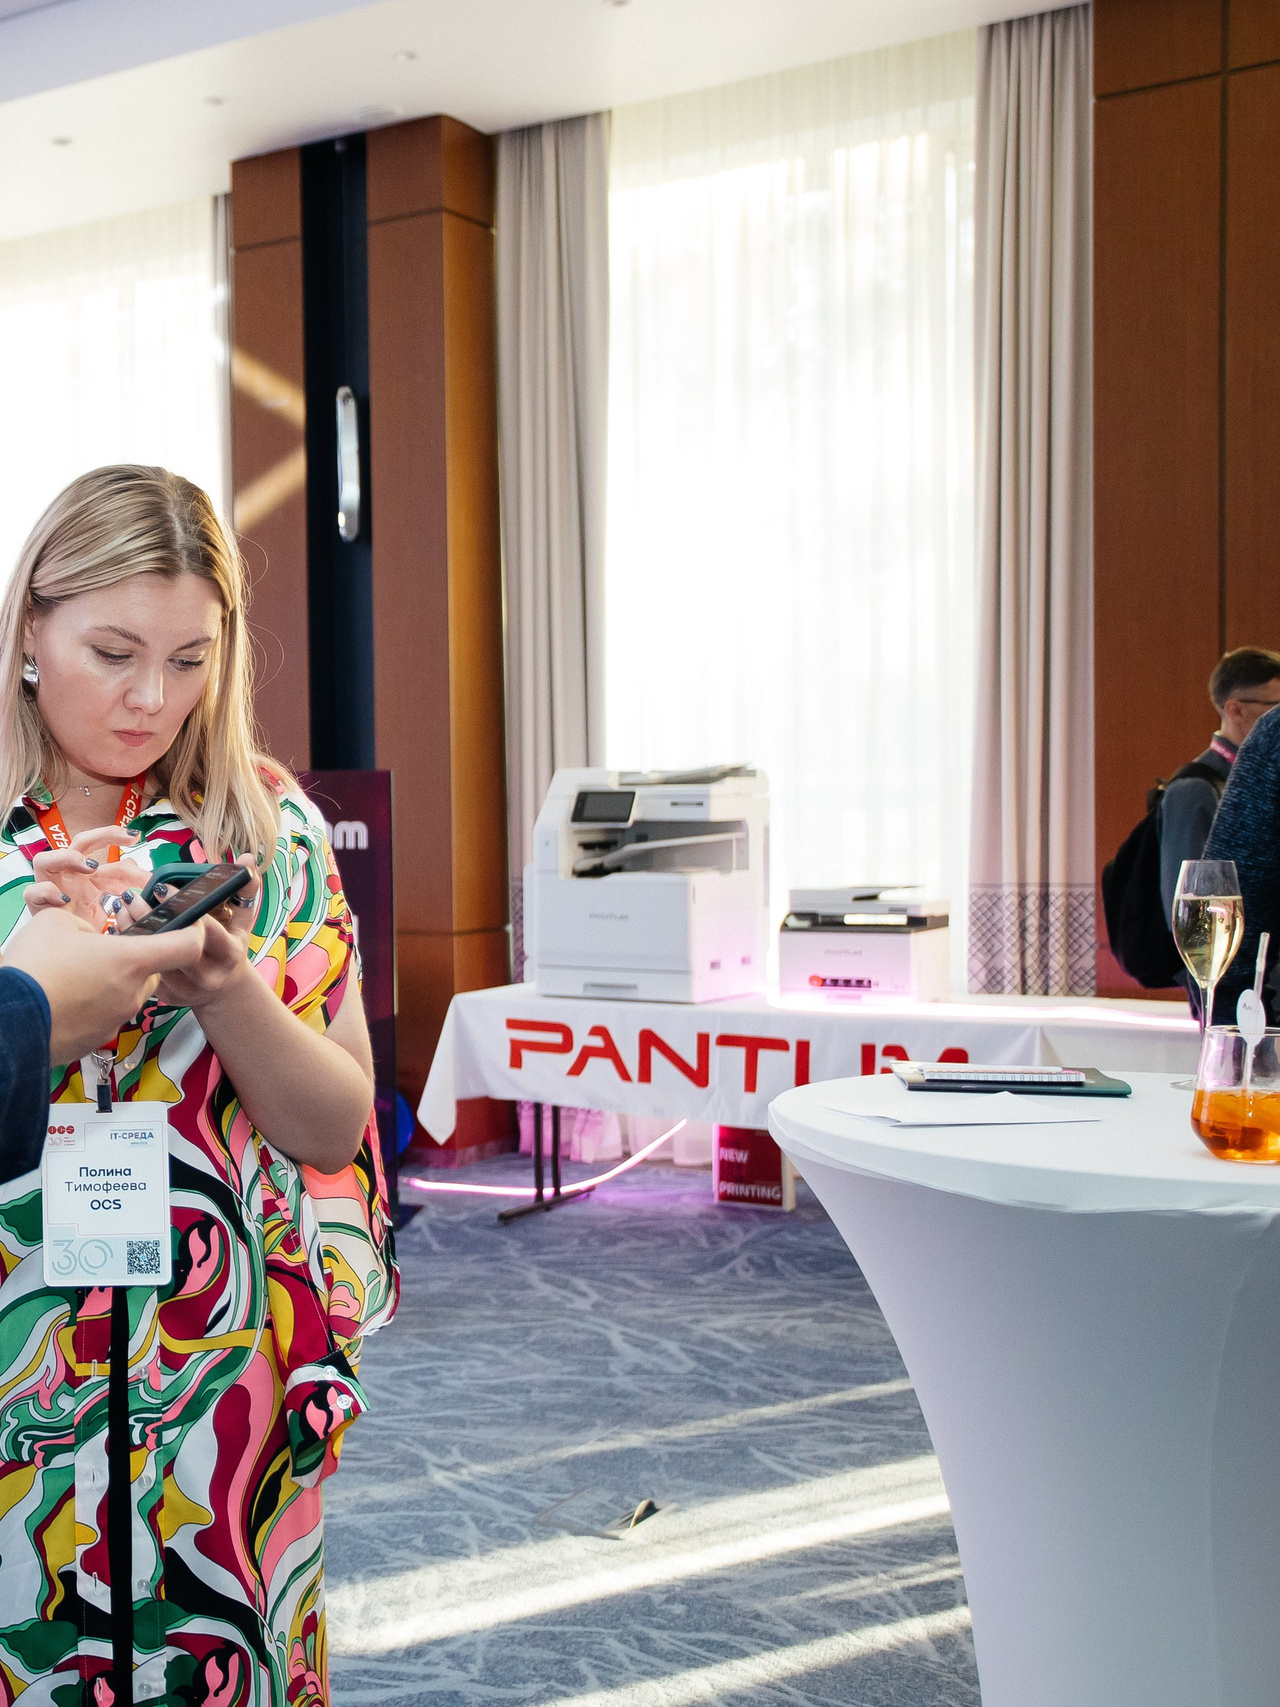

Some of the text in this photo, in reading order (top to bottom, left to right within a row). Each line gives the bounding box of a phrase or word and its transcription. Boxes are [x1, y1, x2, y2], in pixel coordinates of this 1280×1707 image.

[49, 824, 68, 849] ЕДА
[110, 1132, 154, 1140] IT-СРЕДА
[719, 1147, 749, 1164] NEW
[79, 1167, 132, 1178] Полина
[65, 1181, 147, 1194] Тимофеева
[719, 1181, 781, 1199] PRINTING
[90, 1199, 122, 1210] OCS
[51, 1239, 114, 1276] 30
